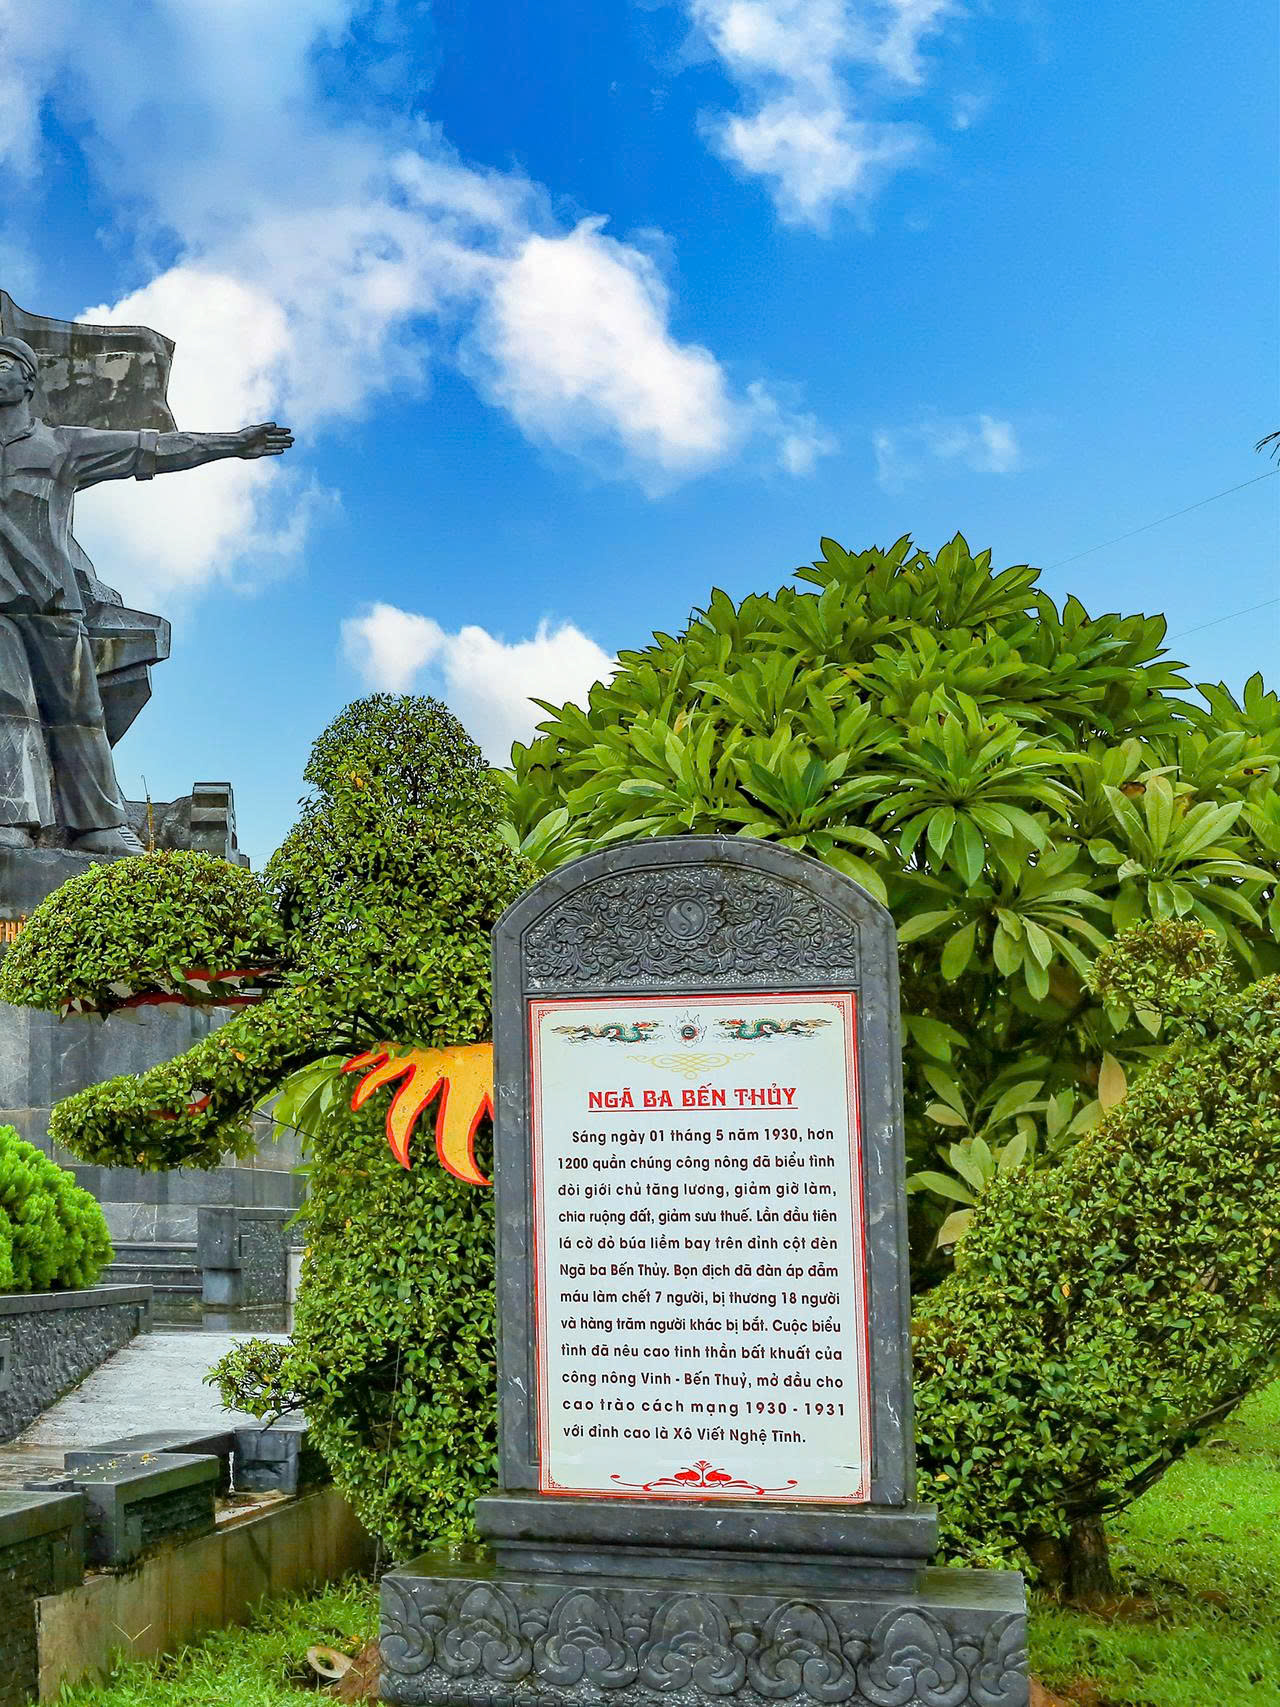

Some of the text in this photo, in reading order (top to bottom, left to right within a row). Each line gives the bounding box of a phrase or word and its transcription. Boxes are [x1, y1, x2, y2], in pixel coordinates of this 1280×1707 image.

[589, 1083, 796, 1109] NGÃ BA BẾN THỦY
[572, 1128, 834, 1146] Sáng ngày 01 tháng 5 năm 1930, hơn
[558, 1151, 835, 1172] 1200 quần chúng công nông đã biểu tình
[558, 1181, 836, 1199] đòi giới chủ tăng lương, giảm giờ làm,
[559, 1206, 837, 1226] chia ruộng đất, giảm sưu thuế. Lần đầu tiên
[559, 1233, 837, 1253] lá cờ đỏ búa liềm bay trên đỉnh cột đèn
[560, 1261, 838, 1280] Ngã ba Bến Thủy. Bọn địch đã đàn áp đẫm
[560, 1288, 840, 1308] máu làm chết 7 người, bị thương 18 người
[561, 1316, 841, 1335] và hàng trăm người khác bị bắt. Cuộc biểu
[561, 1342, 842, 1360] tình đã nêu cao tinh thần bất khuất của
[562, 1370, 596, 1387] công
[602, 1371, 636, 1388] nông
[641, 1372, 671, 1384] Vinh
[684, 1370, 710, 1385] Bến
[714, 1372, 752, 1389] Thuỷ,
[757, 1372, 778, 1387] mở
[783, 1371, 811, 1387] đầu
[816, 1376, 843, 1388] cho
[563, 1400, 594, 1410] cao
[600, 1398, 635, 1411] trào
[641, 1398, 684, 1412] cách
[691, 1403, 738, 1417] mạng
[746, 1401, 787, 1415] 1930
[805, 1403, 844, 1416] 1931
[563, 1423, 806, 1445] với đỉnh cao là Xô Viết Nghệ Tĩnh.
